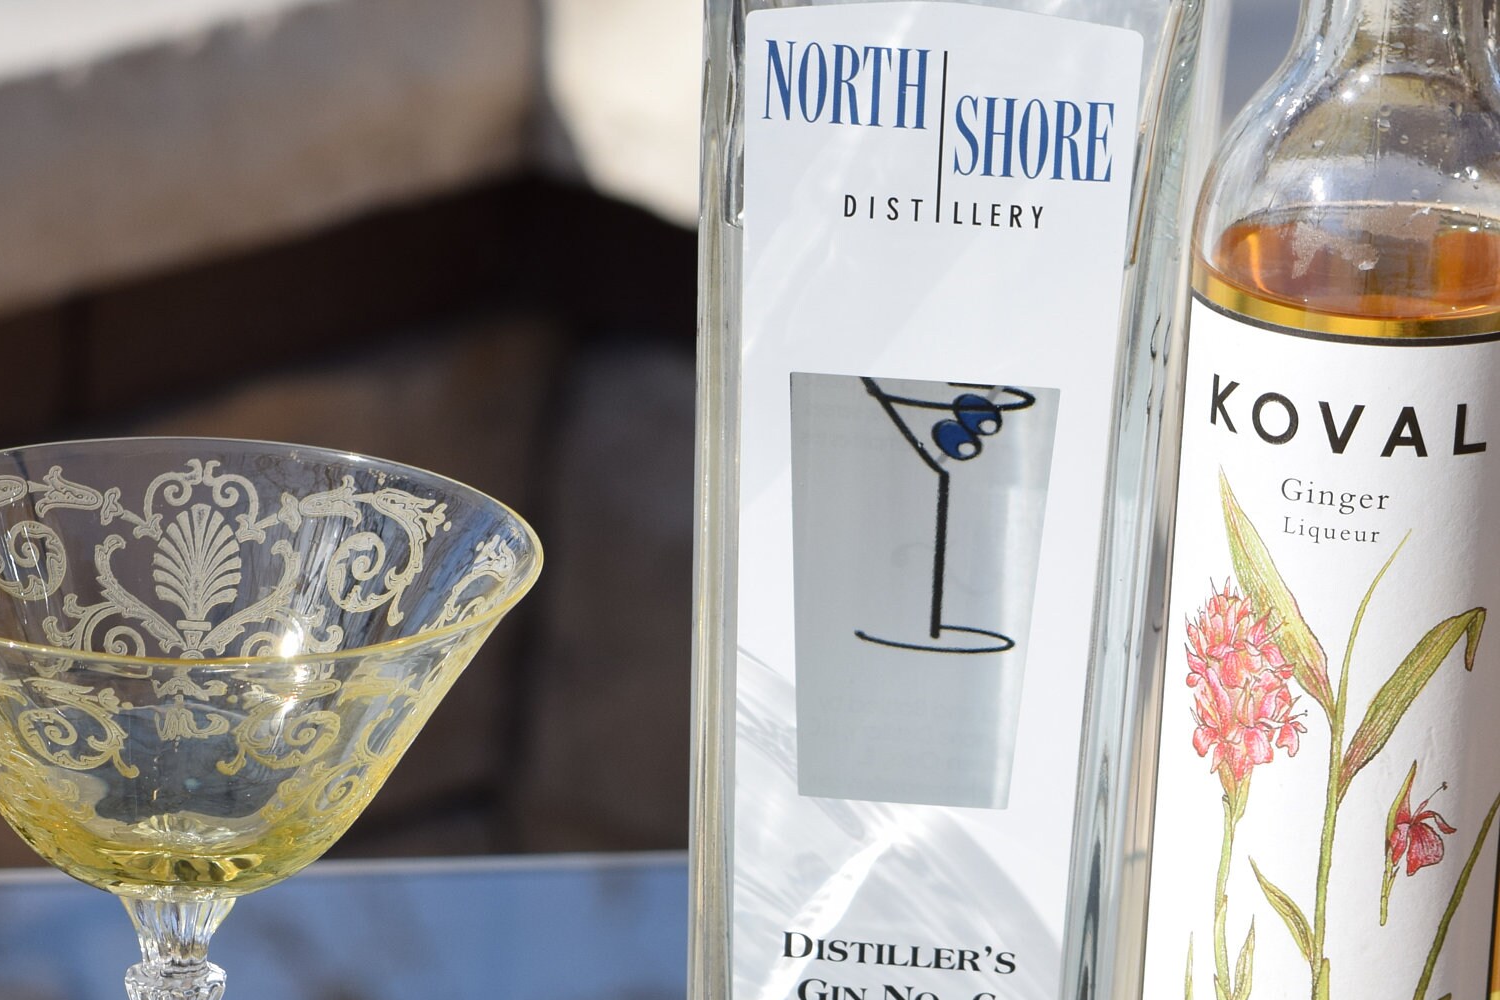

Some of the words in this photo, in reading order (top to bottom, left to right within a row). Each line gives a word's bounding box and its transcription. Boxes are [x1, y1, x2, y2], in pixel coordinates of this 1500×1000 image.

[762, 40, 931, 129] NORTH
[953, 96, 1114, 181] SHORE
[1209, 374, 1487, 457] KOVAL
[1281, 478, 1390, 513] Ginger
[1283, 517, 1381, 543] Liqueur
[783, 931, 1016, 974] DISTILLER'S
